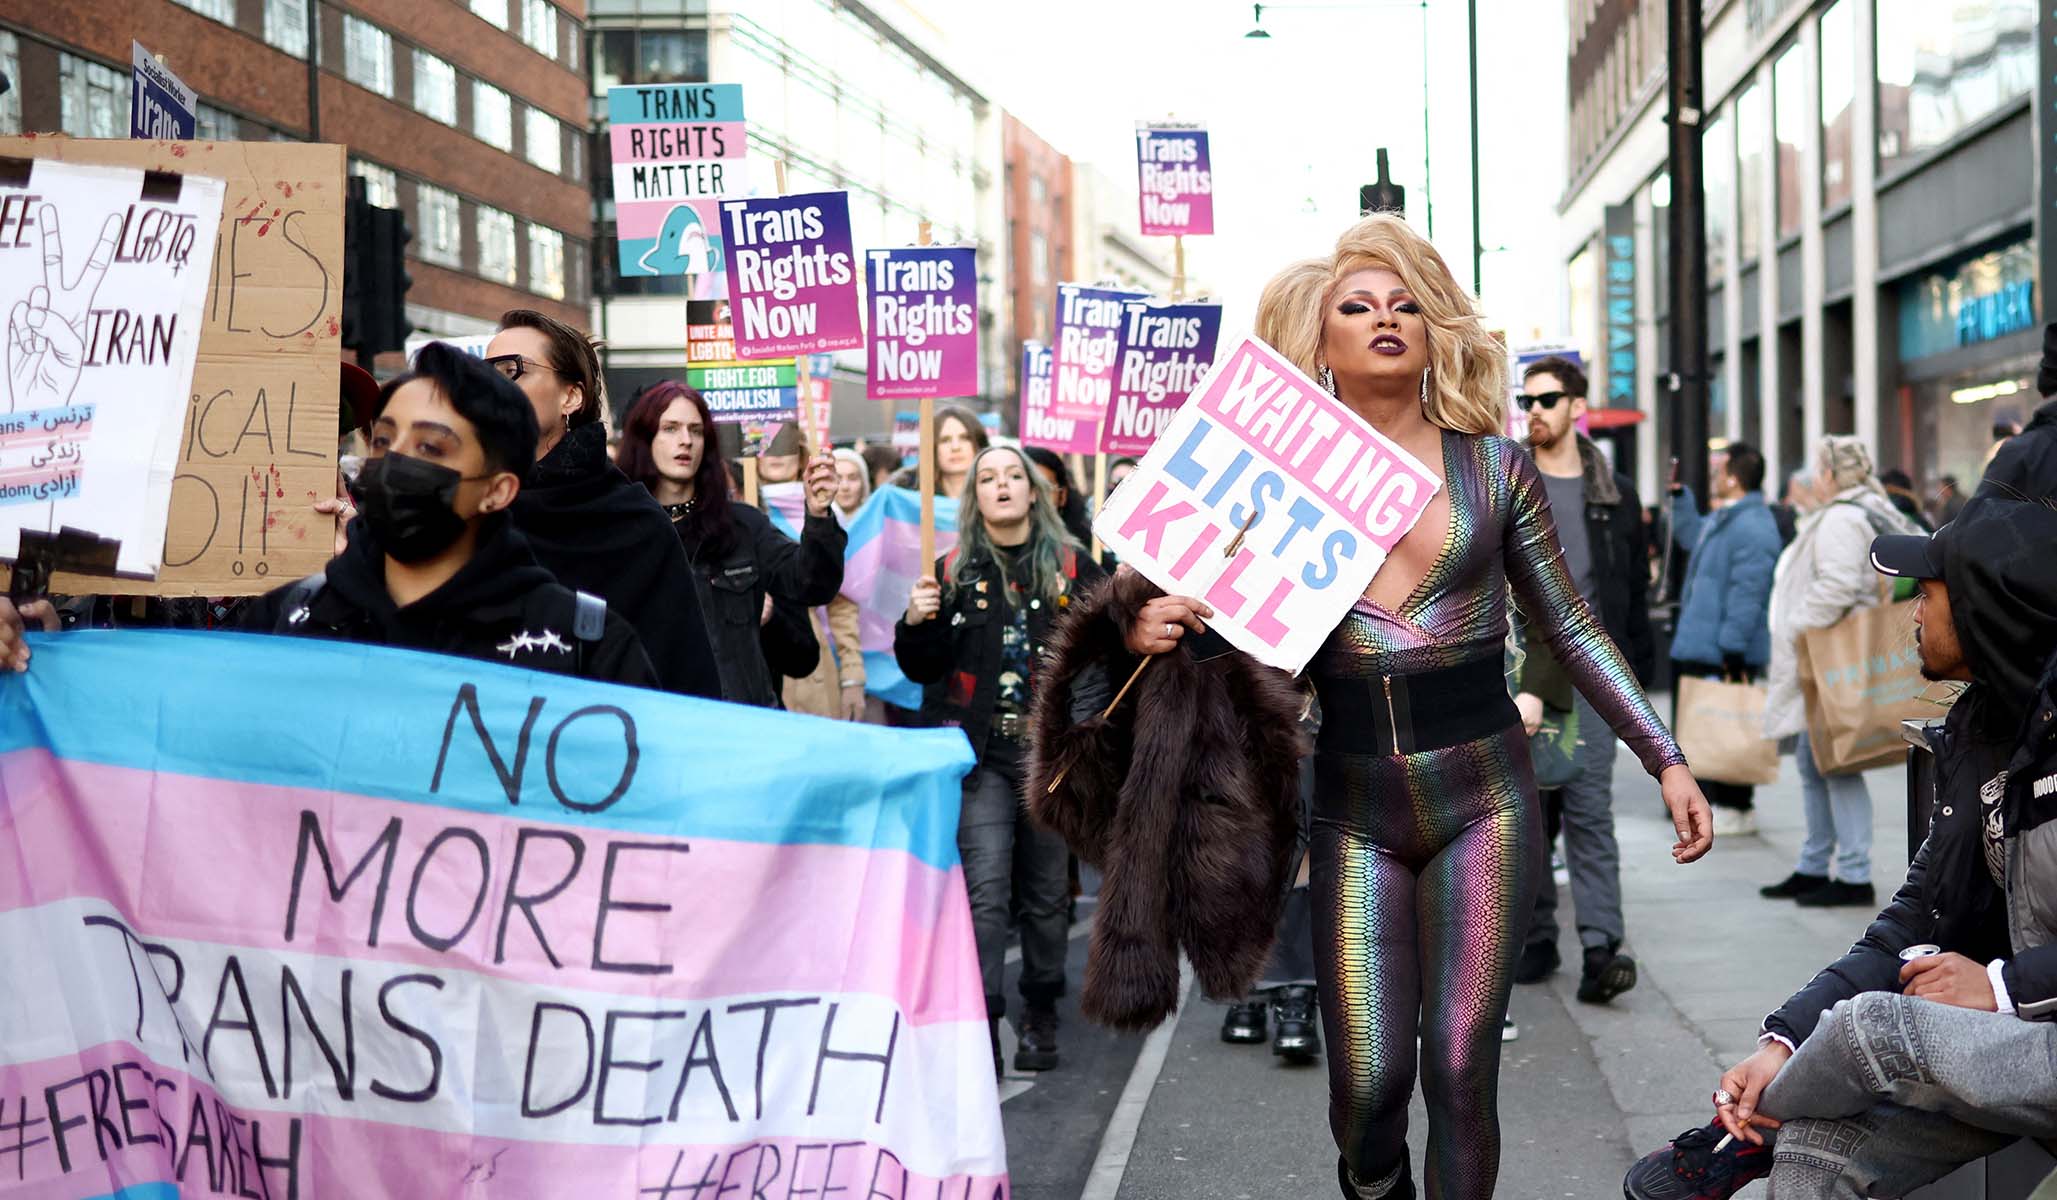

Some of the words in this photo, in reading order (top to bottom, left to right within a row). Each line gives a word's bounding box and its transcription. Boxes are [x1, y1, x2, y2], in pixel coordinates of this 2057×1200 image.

[134, 70, 180, 139] Trans
[637, 88, 716, 120] TRANS
[631, 126, 725, 159] RIGHTS
[1137, 131, 1198, 162] Trans
[633, 163, 724, 199] MATTER
[1141, 162, 1211, 201] Rights
[724, 202, 824, 246] Trans
[1143, 194, 1190, 226] Now
[114, 204, 198, 270] LGBTQ
[736, 244, 852, 301] Rights
[869, 251, 955, 292] Trans
[741, 296, 816, 341] Now
[876, 294, 973, 346] Rights
[1061, 287, 1122, 328] Tran
[1126, 304, 1201, 349] Trans
[82, 308, 178, 367] IRAN
[1060, 326, 1118, 375] Righ
[704, 368, 745, 389] FIGHT
[748, 367, 778, 388] FOR
[877, 340, 943, 381] Now
[704, 388, 781, 410] SOCIALISM
[1025, 407, 1076, 441] Now
[1218, 352, 1417, 536] WAITING
[1163, 418, 1358, 590] LISTS
[1118, 481, 1295, 649] KILL
[429, 682, 640, 814] NO
[284, 810, 690, 974] MORE
[83, 915, 446, 1103] TRANS
[521, 996, 900, 1126] DEATH
